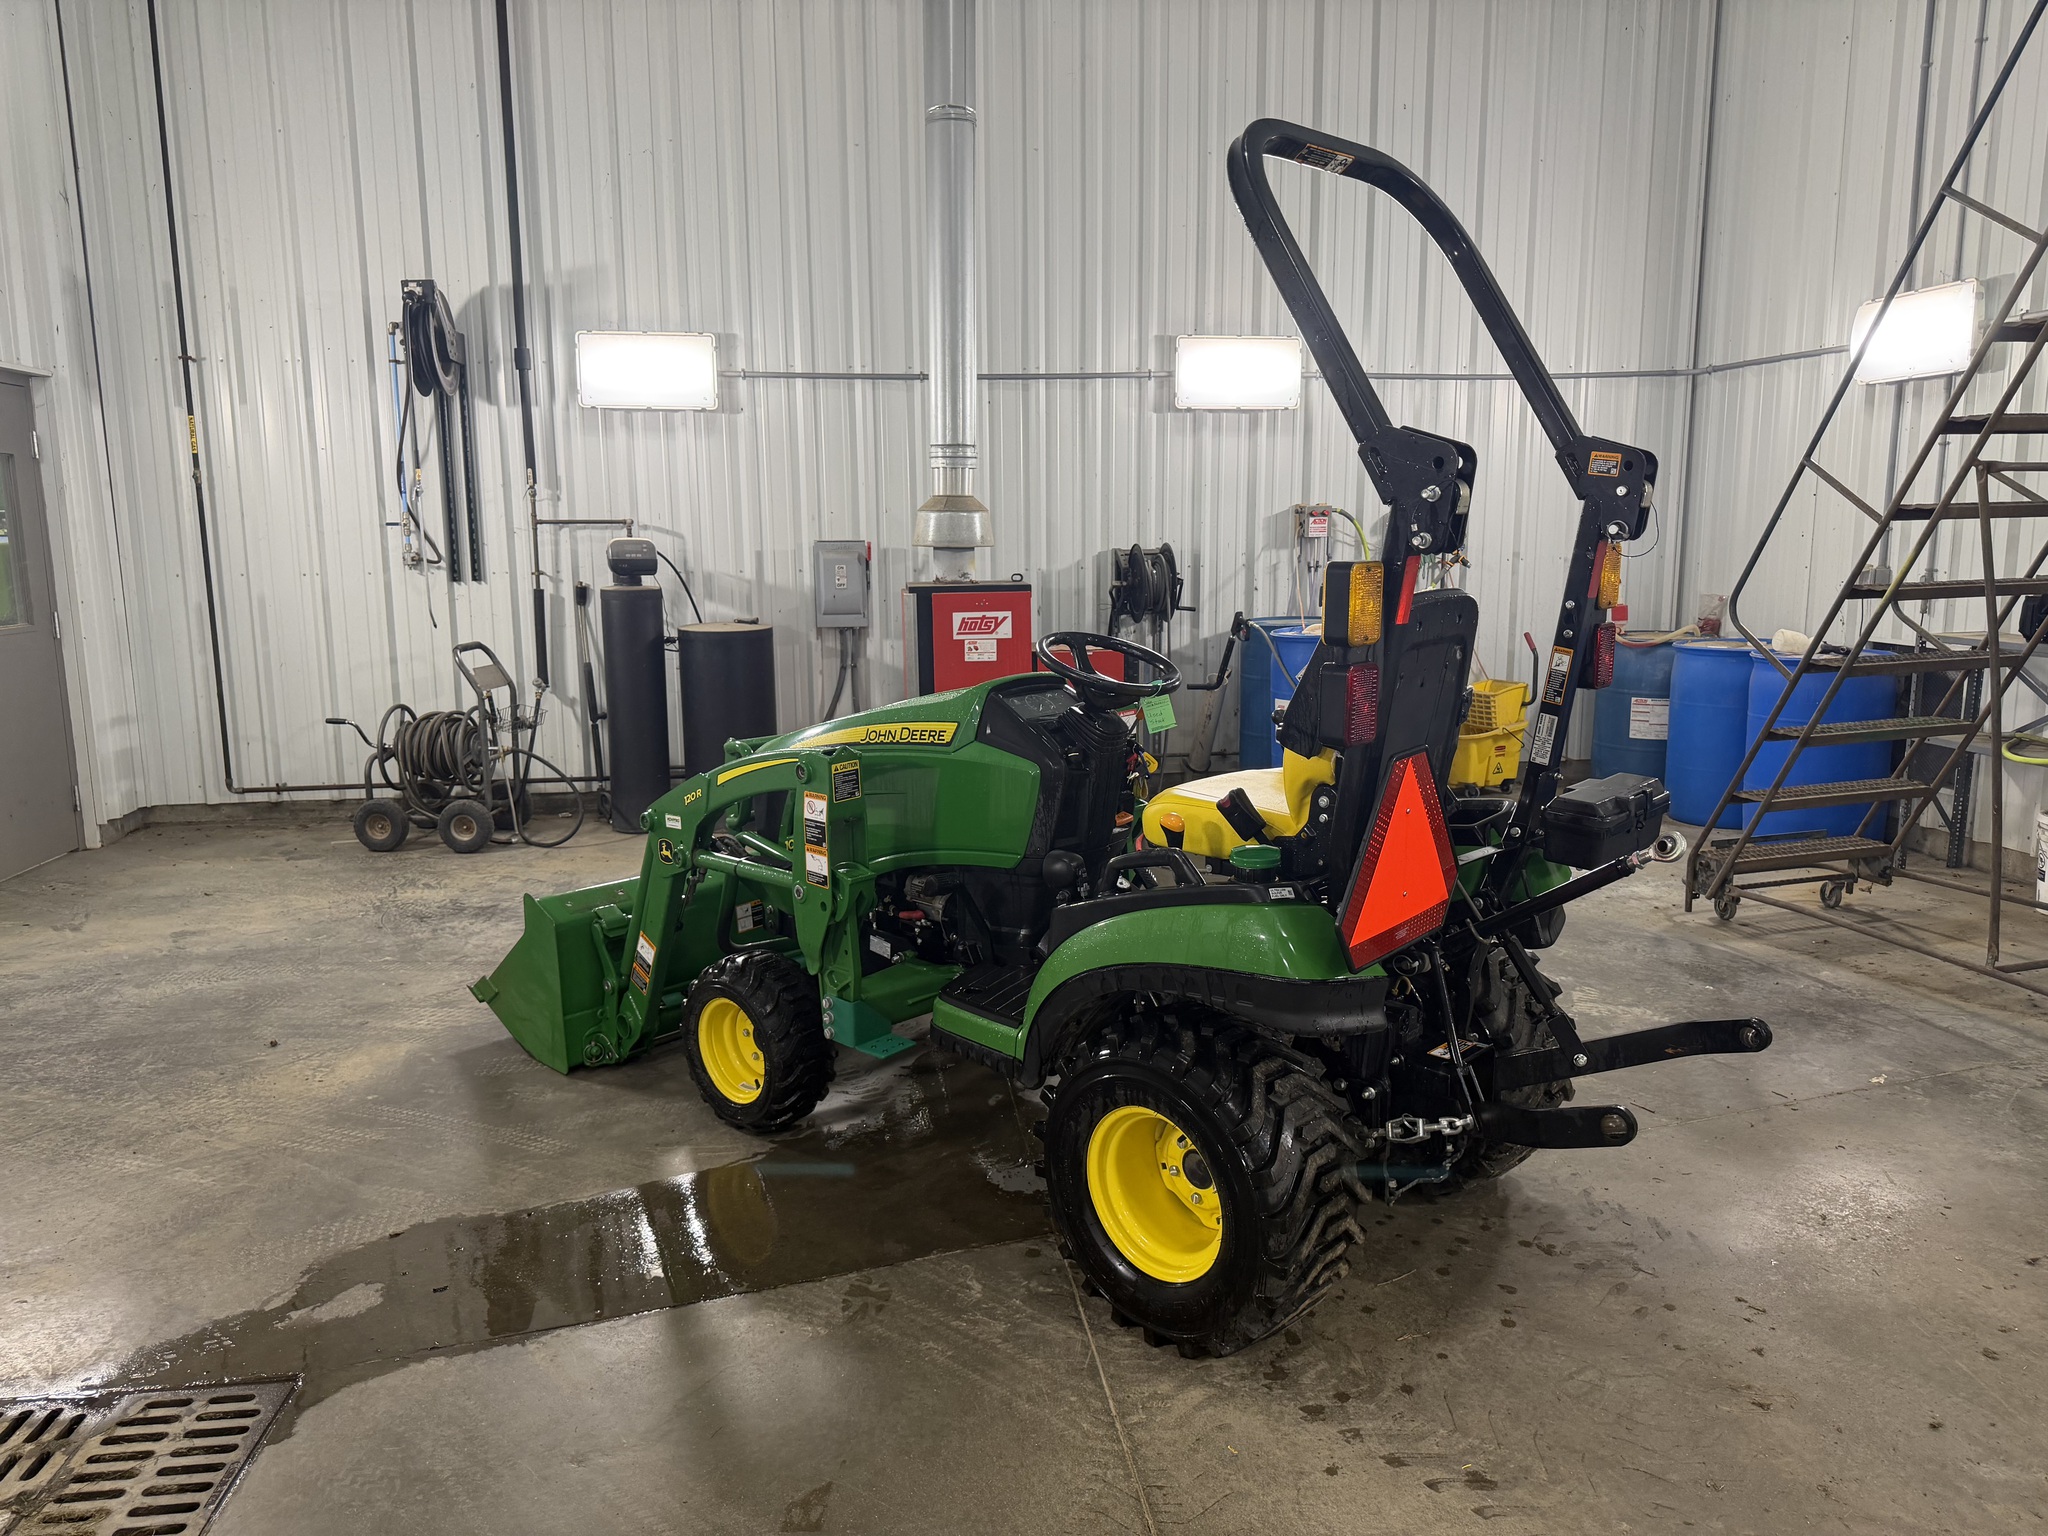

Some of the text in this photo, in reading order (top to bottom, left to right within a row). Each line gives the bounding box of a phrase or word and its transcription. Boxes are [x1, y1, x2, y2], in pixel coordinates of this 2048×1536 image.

[956, 614, 1010, 636] hotsy
[860, 727, 947, 742] JOHN DEERE
[839, 761, 858, 770] CAUTION
